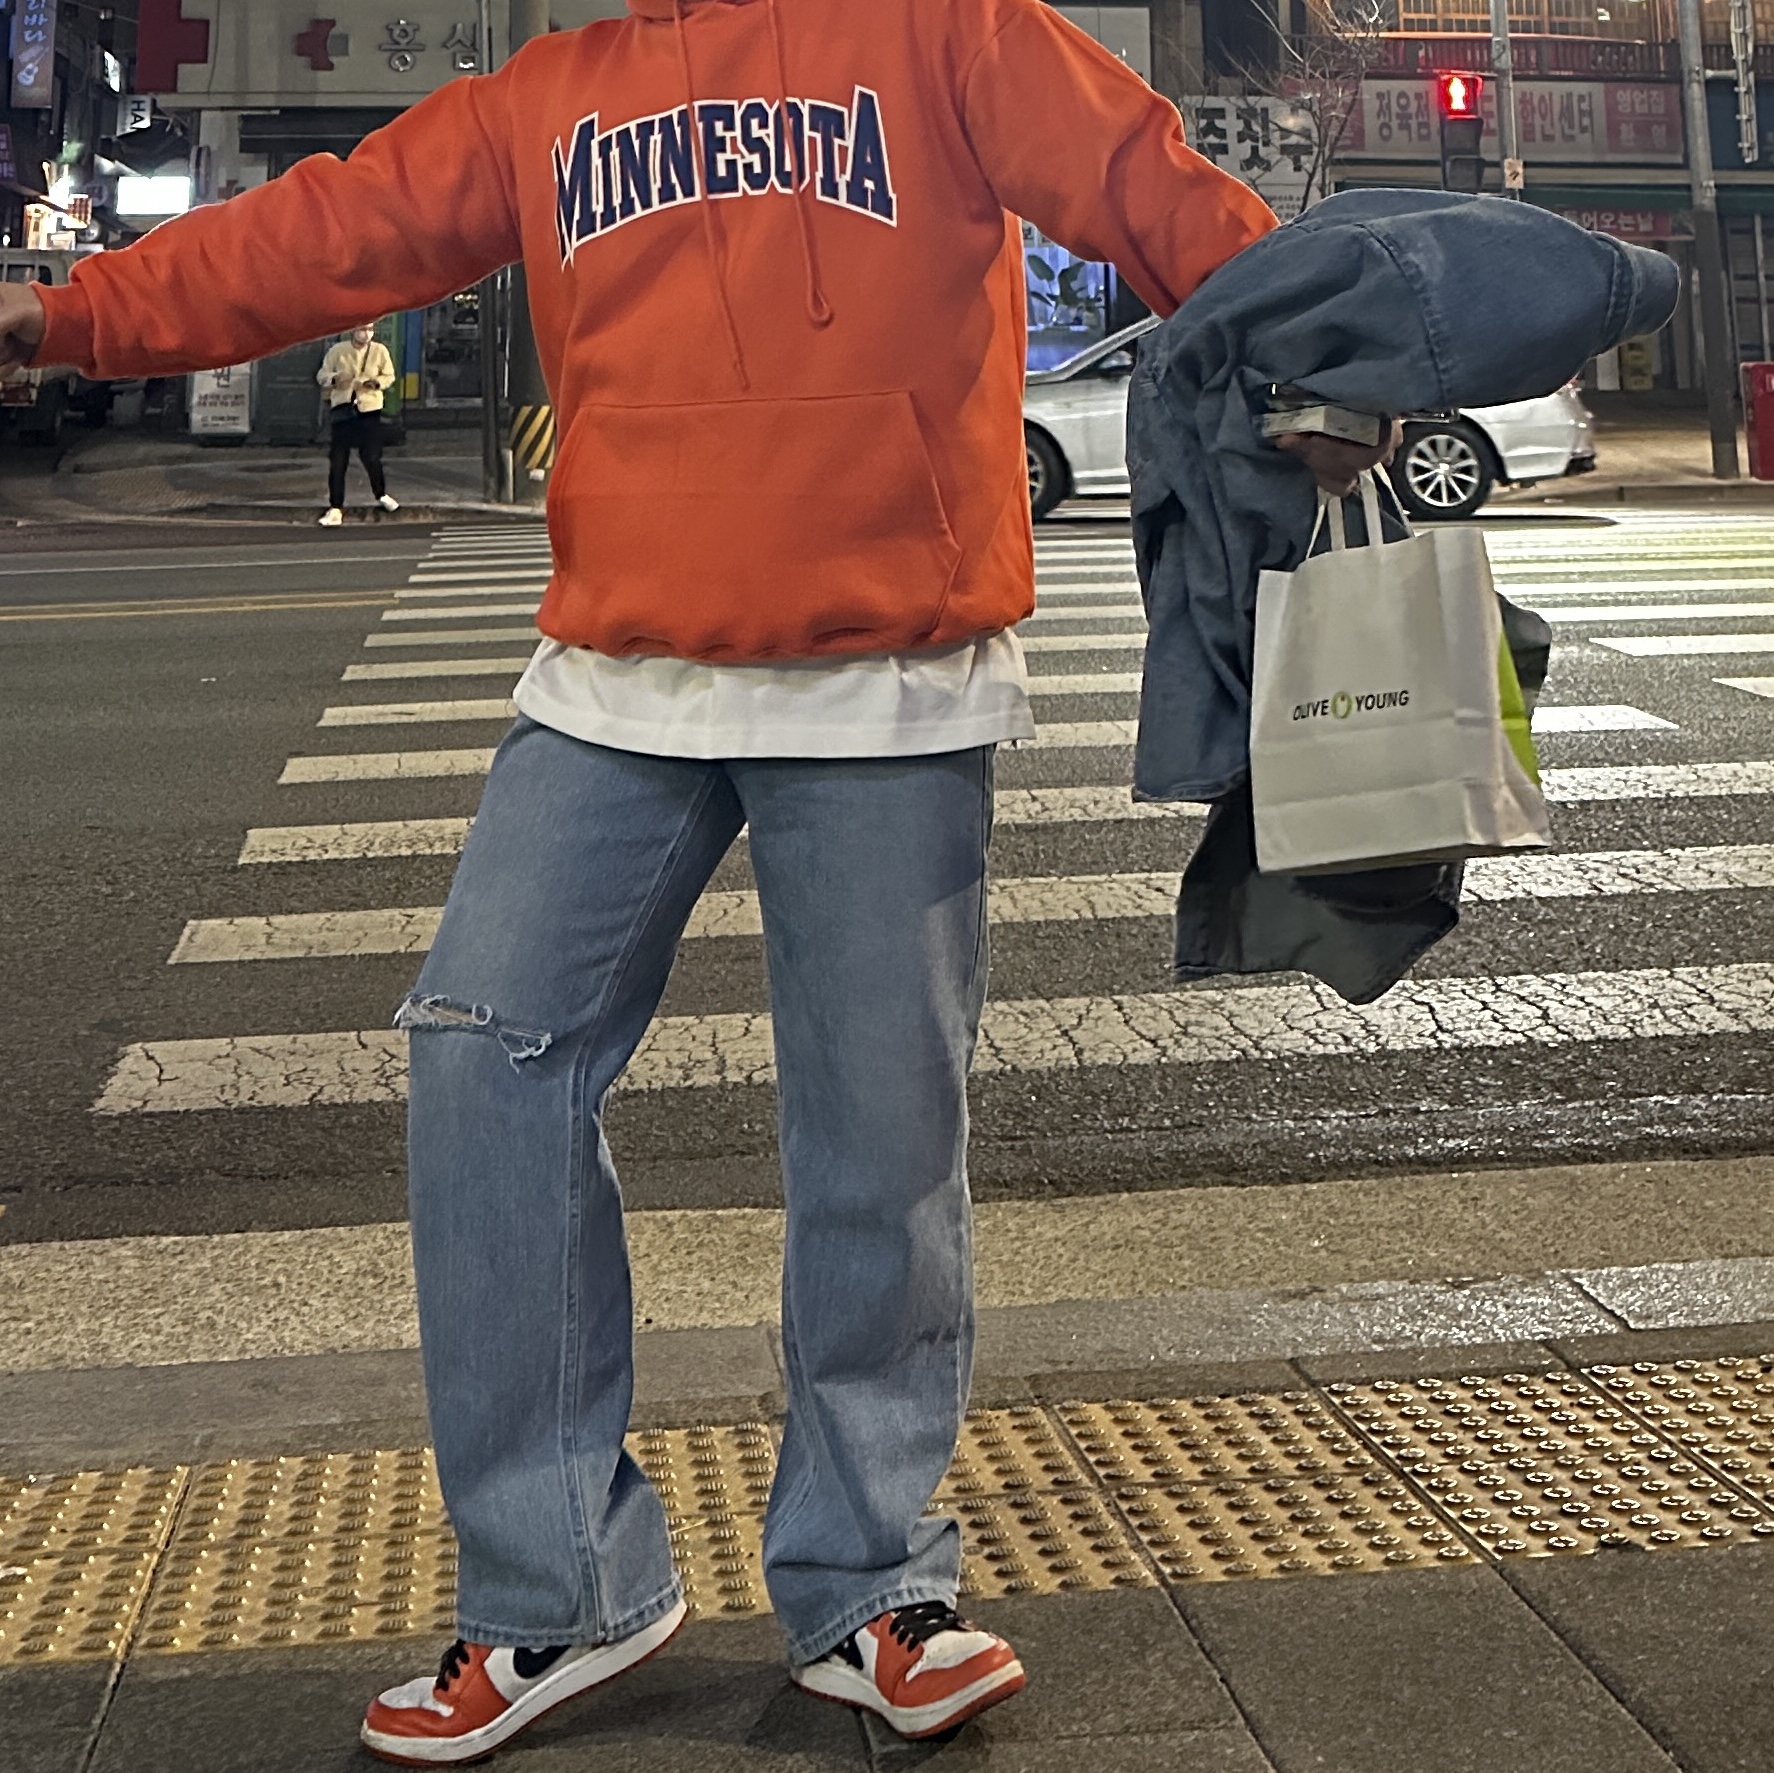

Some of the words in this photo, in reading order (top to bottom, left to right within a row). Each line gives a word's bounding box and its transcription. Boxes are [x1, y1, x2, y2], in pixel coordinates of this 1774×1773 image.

[1376, 90, 1432, 143] 정육점
[1519, 90, 1595, 144] 할인센터
[551, 84, 897, 273] MINNESOTA
[1292, 699, 1330, 721] OLIVE
[1355, 689, 1410, 712] YOUNG
